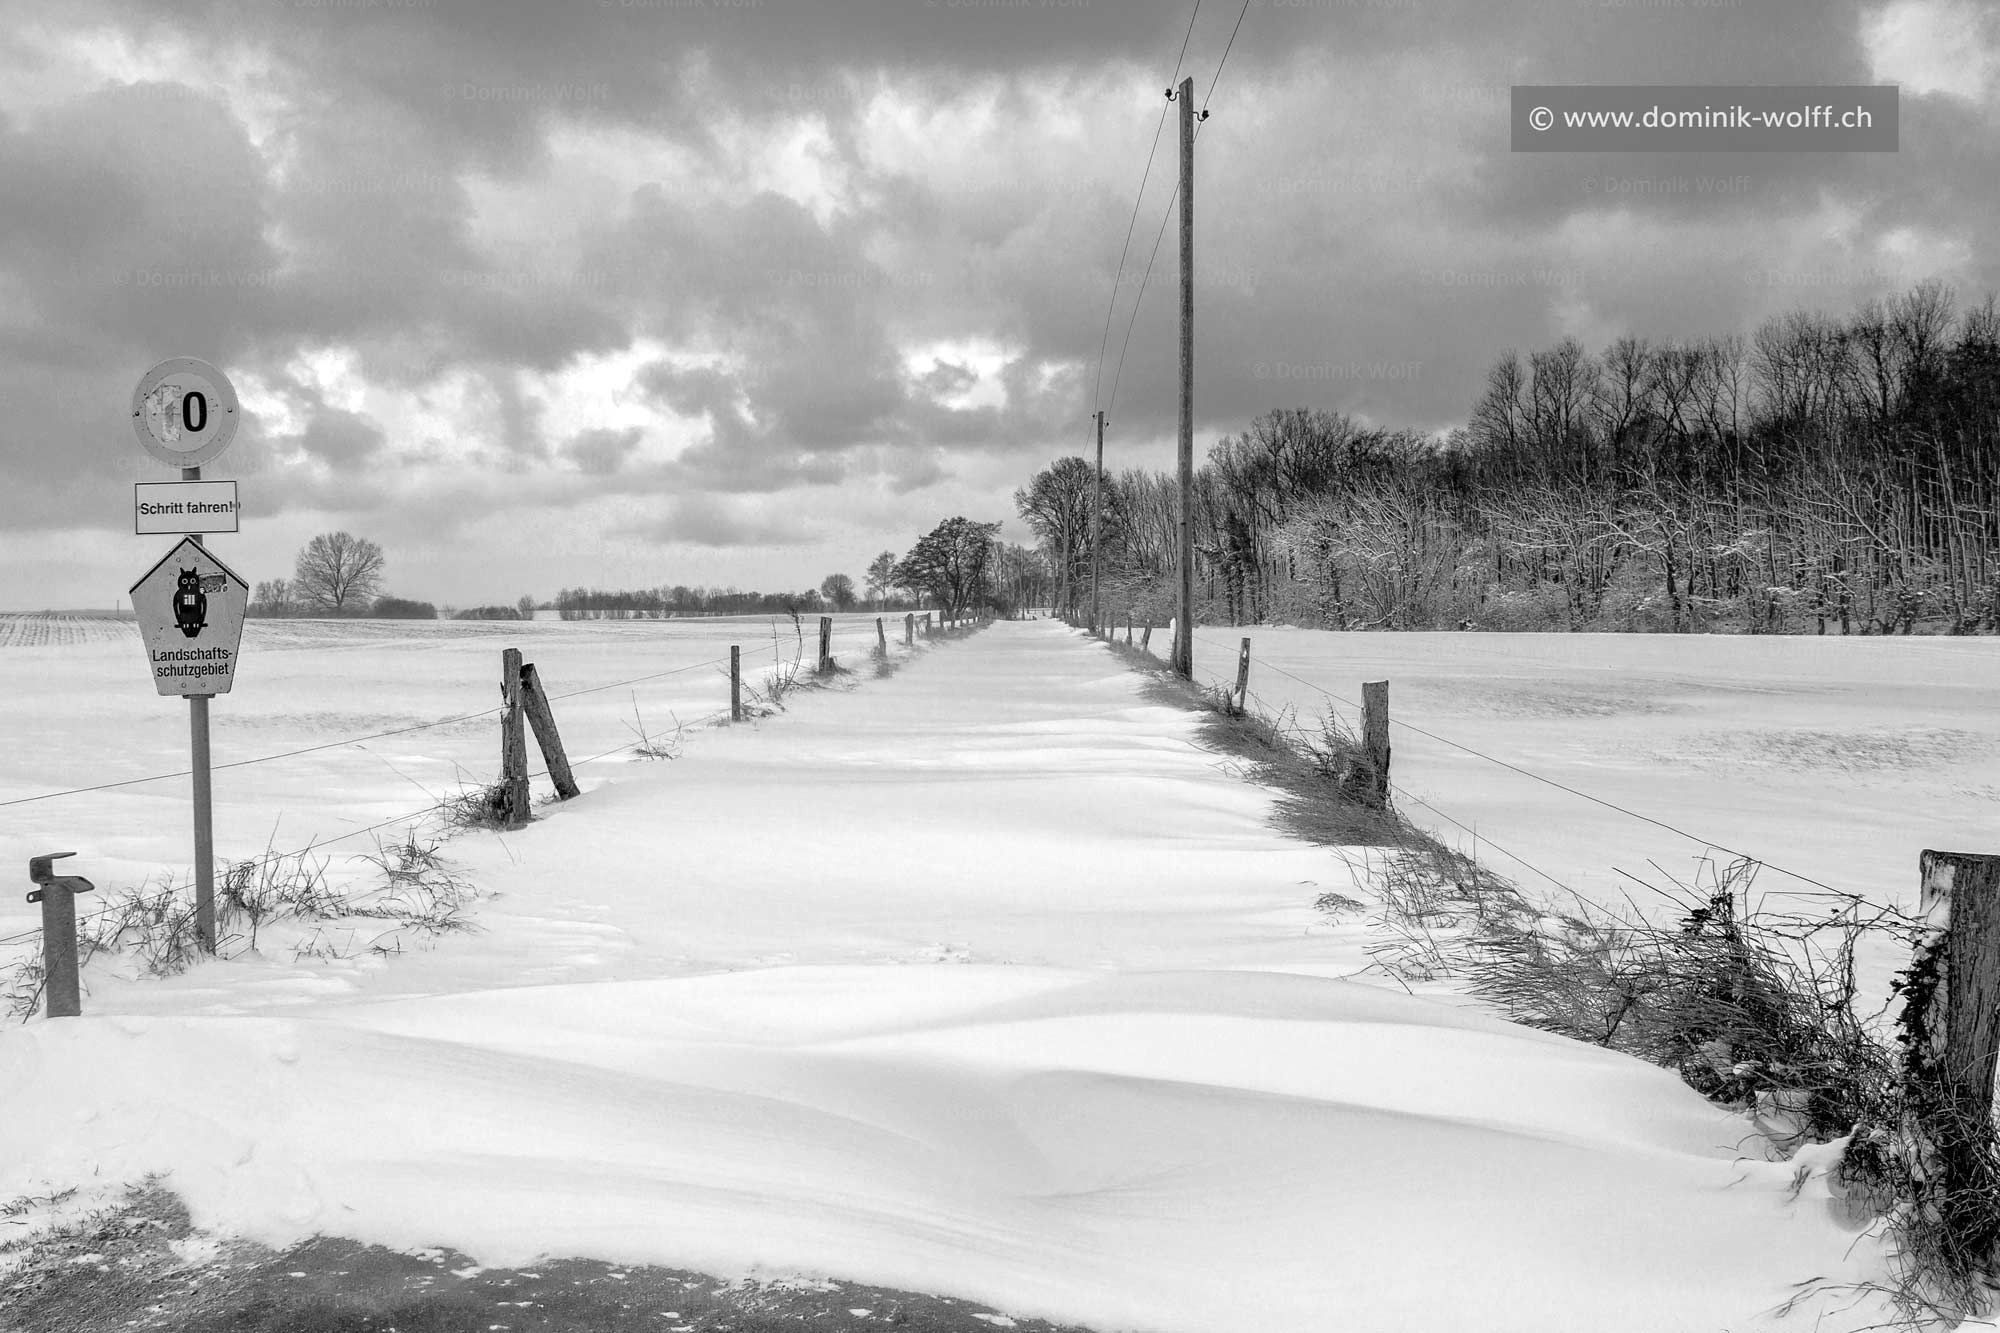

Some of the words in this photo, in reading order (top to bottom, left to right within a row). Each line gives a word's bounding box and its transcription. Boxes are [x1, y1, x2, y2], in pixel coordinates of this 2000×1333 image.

[182, 391, 208, 432] 0
[140, 502, 183, 514] Schritt
[186, 500, 233, 513] fahren!
[152, 647, 233, 661] Landschafts-
[157, 662, 229, 678] schutzgebiet
